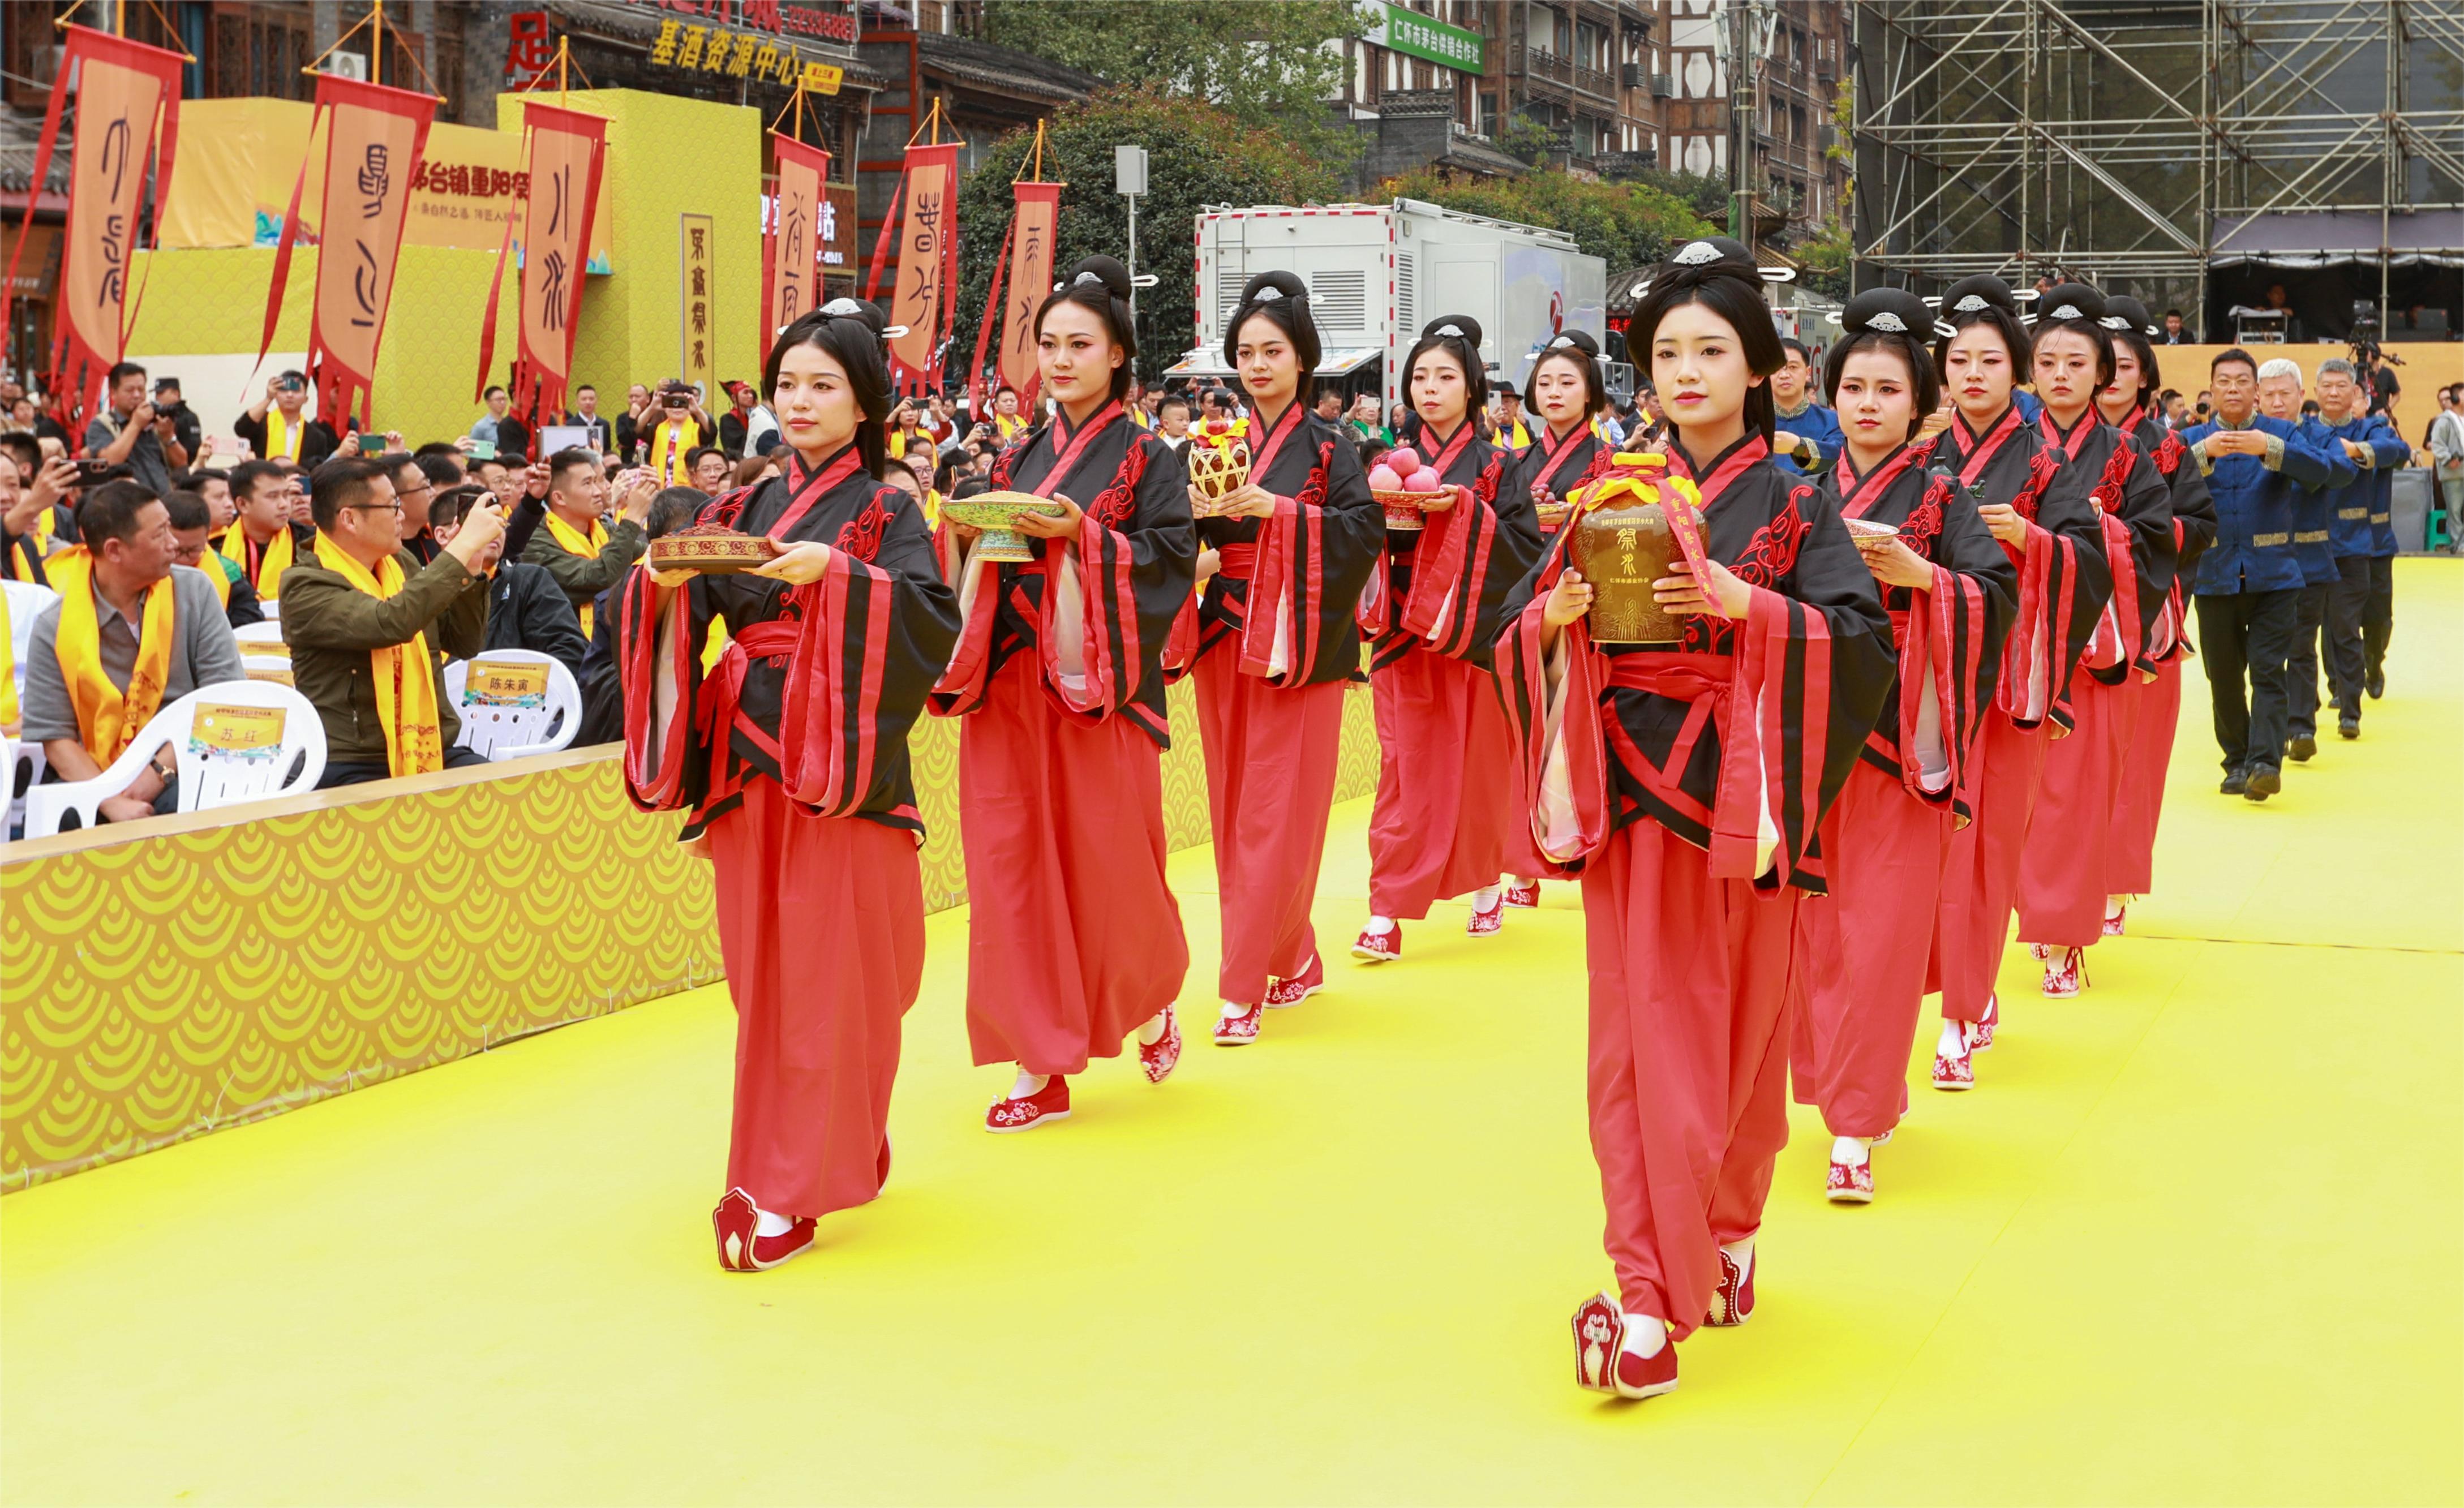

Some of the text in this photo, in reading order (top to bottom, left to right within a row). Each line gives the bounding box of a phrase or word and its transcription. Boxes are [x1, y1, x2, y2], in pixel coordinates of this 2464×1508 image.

[652, 18, 799, 85] 基酒资源中心
[1394, 18, 1479, 64] 仁怀市茅台供销合作社
[1670, 497, 1712, 596] 重阳祭水大典
[490, 677, 529, 691] 陈朱寅
